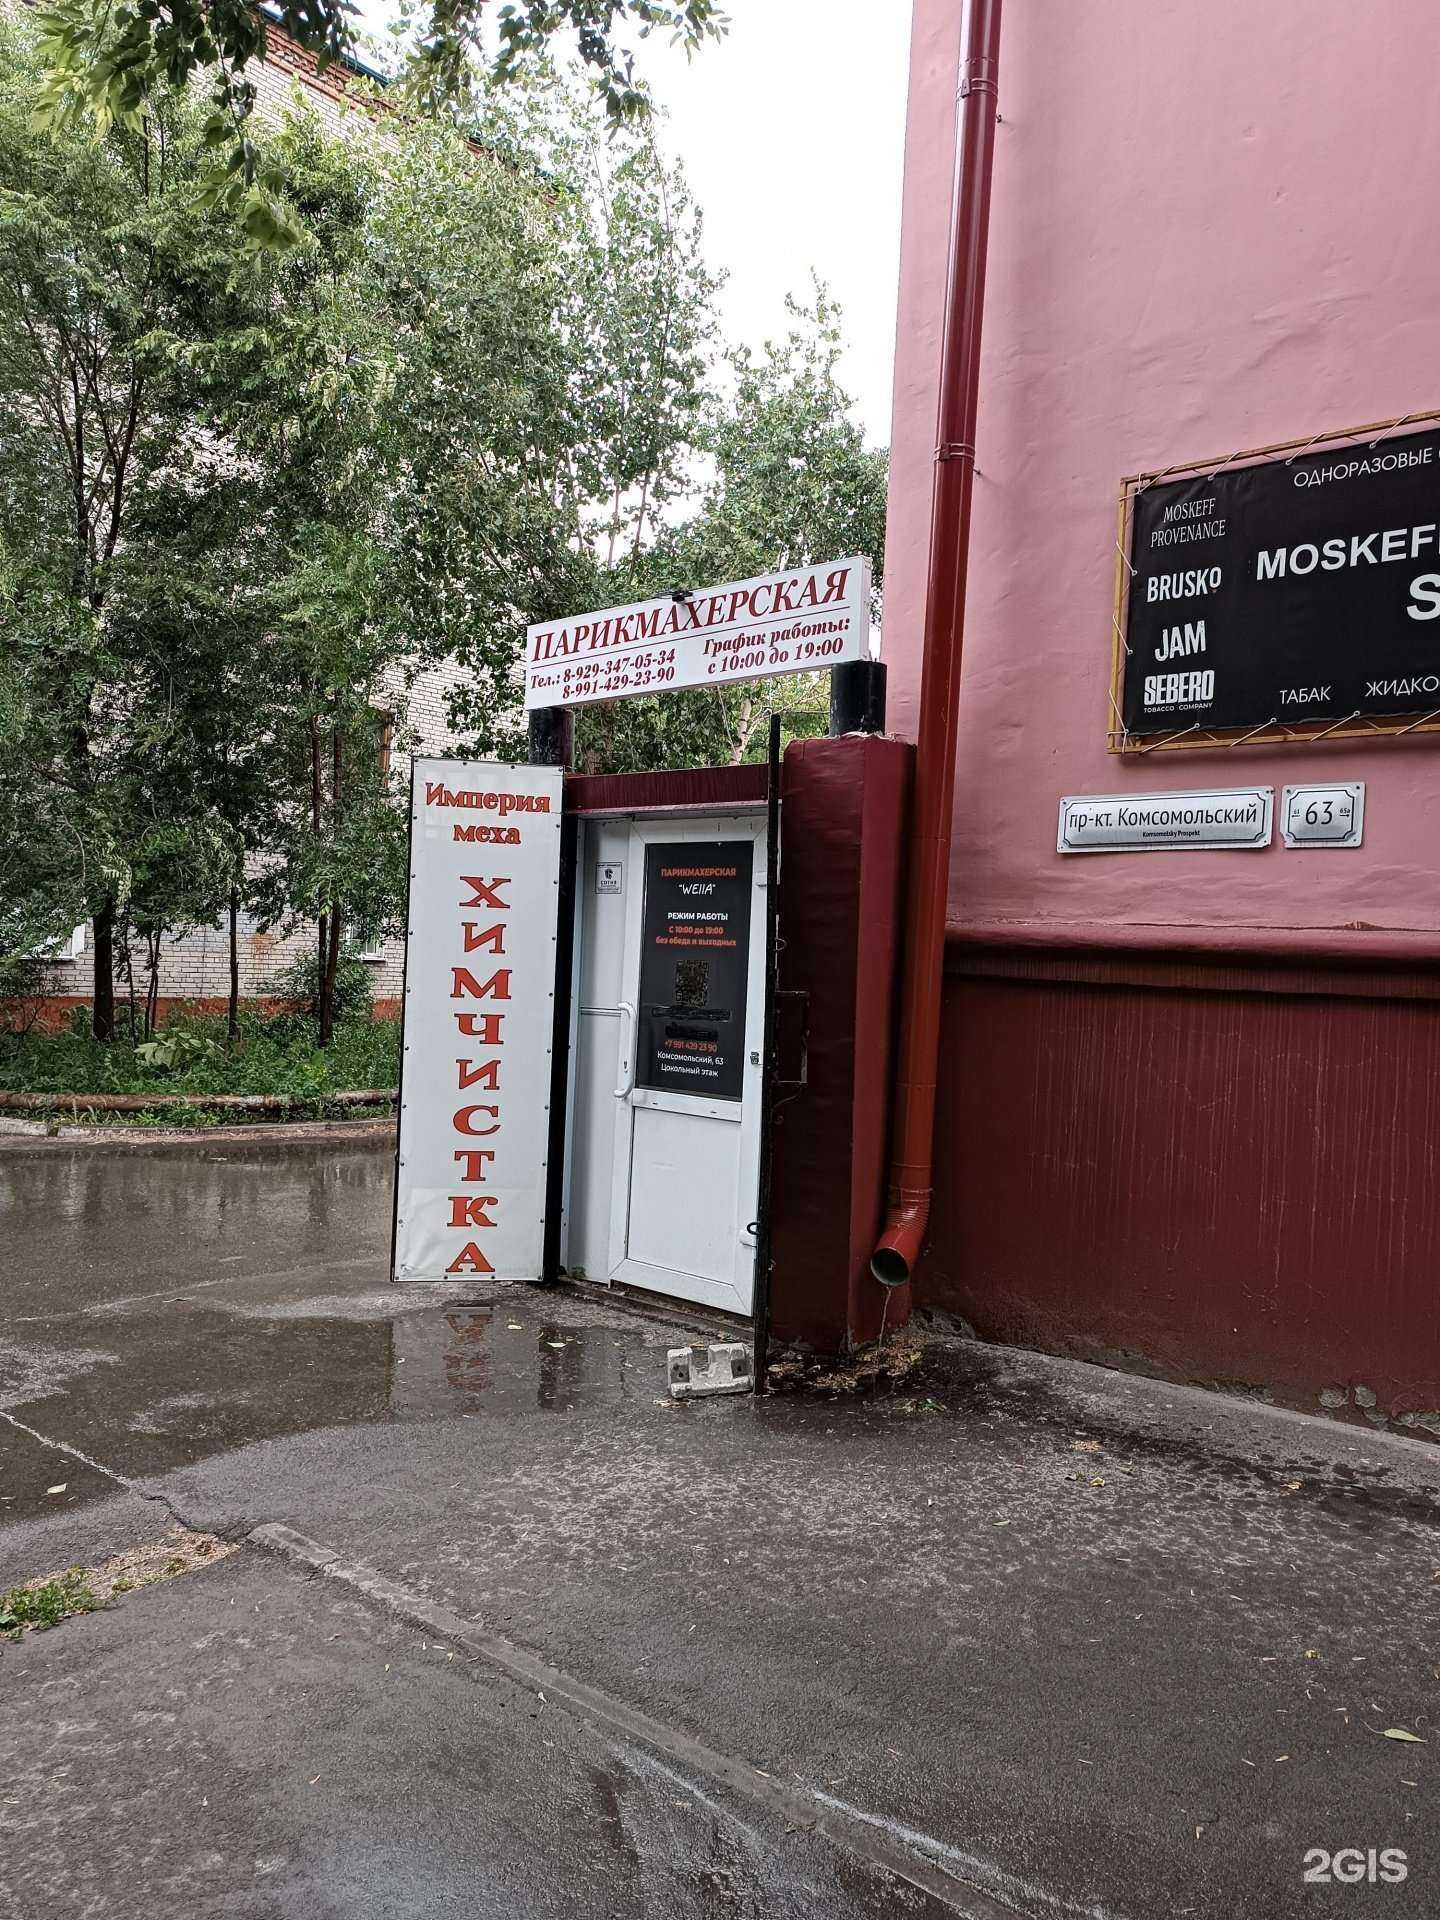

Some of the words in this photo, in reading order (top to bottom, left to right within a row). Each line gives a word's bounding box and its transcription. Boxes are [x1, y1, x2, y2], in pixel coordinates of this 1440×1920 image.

[1293, 447, 1433, 488] ОДНОРАЗОВЫЕ
[1162, 497, 1216, 524] MOSKEFF
[1150, 519, 1226, 548] PROVENANCE
[1256, 523, 1440, 581] MOSKEF
[1147, 566, 1222, 603] BRUSKO
[531, 567, 852, 663] ПАРИКМАХЕРСКАЯ
[703, 631, 767, 657] График
[769, 617, 851, 648] работы:
[1154, 620, 1207, 662] JAM
[530, 674, 561, 690] Тел.:
[563, 648, 676, 684] 8-929-347-05-34
[720, 650, 765, 673] 10:00
[769, 647, 789, 665] до
[795, 637, 844, 661] 19:00
[562, 666, 676, 700] 8-991-429-23-90
[1143, 669, 1216, 706] SEBERO
[1279, 686, 1331, 705] ТАБАК
[1143, 705, 1175, 714] TOBACCO
[1178, 702, 1214, 711] COMPANY
[425, 783, 551, 814] Империя
[1305, 800, 1334, 825] 63
[1068, 810, 1113, 831] пр-кт.
[1117, 802, 1258, 826] Комсомольский
[453, 823, 521, 845] меха
[660, 867, 737, 878] ПАРИКМАХЕРСКАЯ
[667, 912, 695, 921] РЕЖИМ
[696, 912, 729, 921] РАБОТЫ
[675, 926, 694, 934] 10:00
[694, 928, 704, 936] до
[705, 926, 724, 935] 19:00
[655, 936, 668, 944] без
[669, 937, 691, 946] обеда
[698, 939, 737, 947] выходных
[657, 1050, 714, 1065] Комсомольский,
[715, 1057, 725, 1066] 63
[707, 1044, 718, 1053] 90
[446, 875, 512, 1273] ХИМЧИСТКА
[660, 1062, 701, 1075] Цокольный
[701, 1068, 719, 1078] этаж
